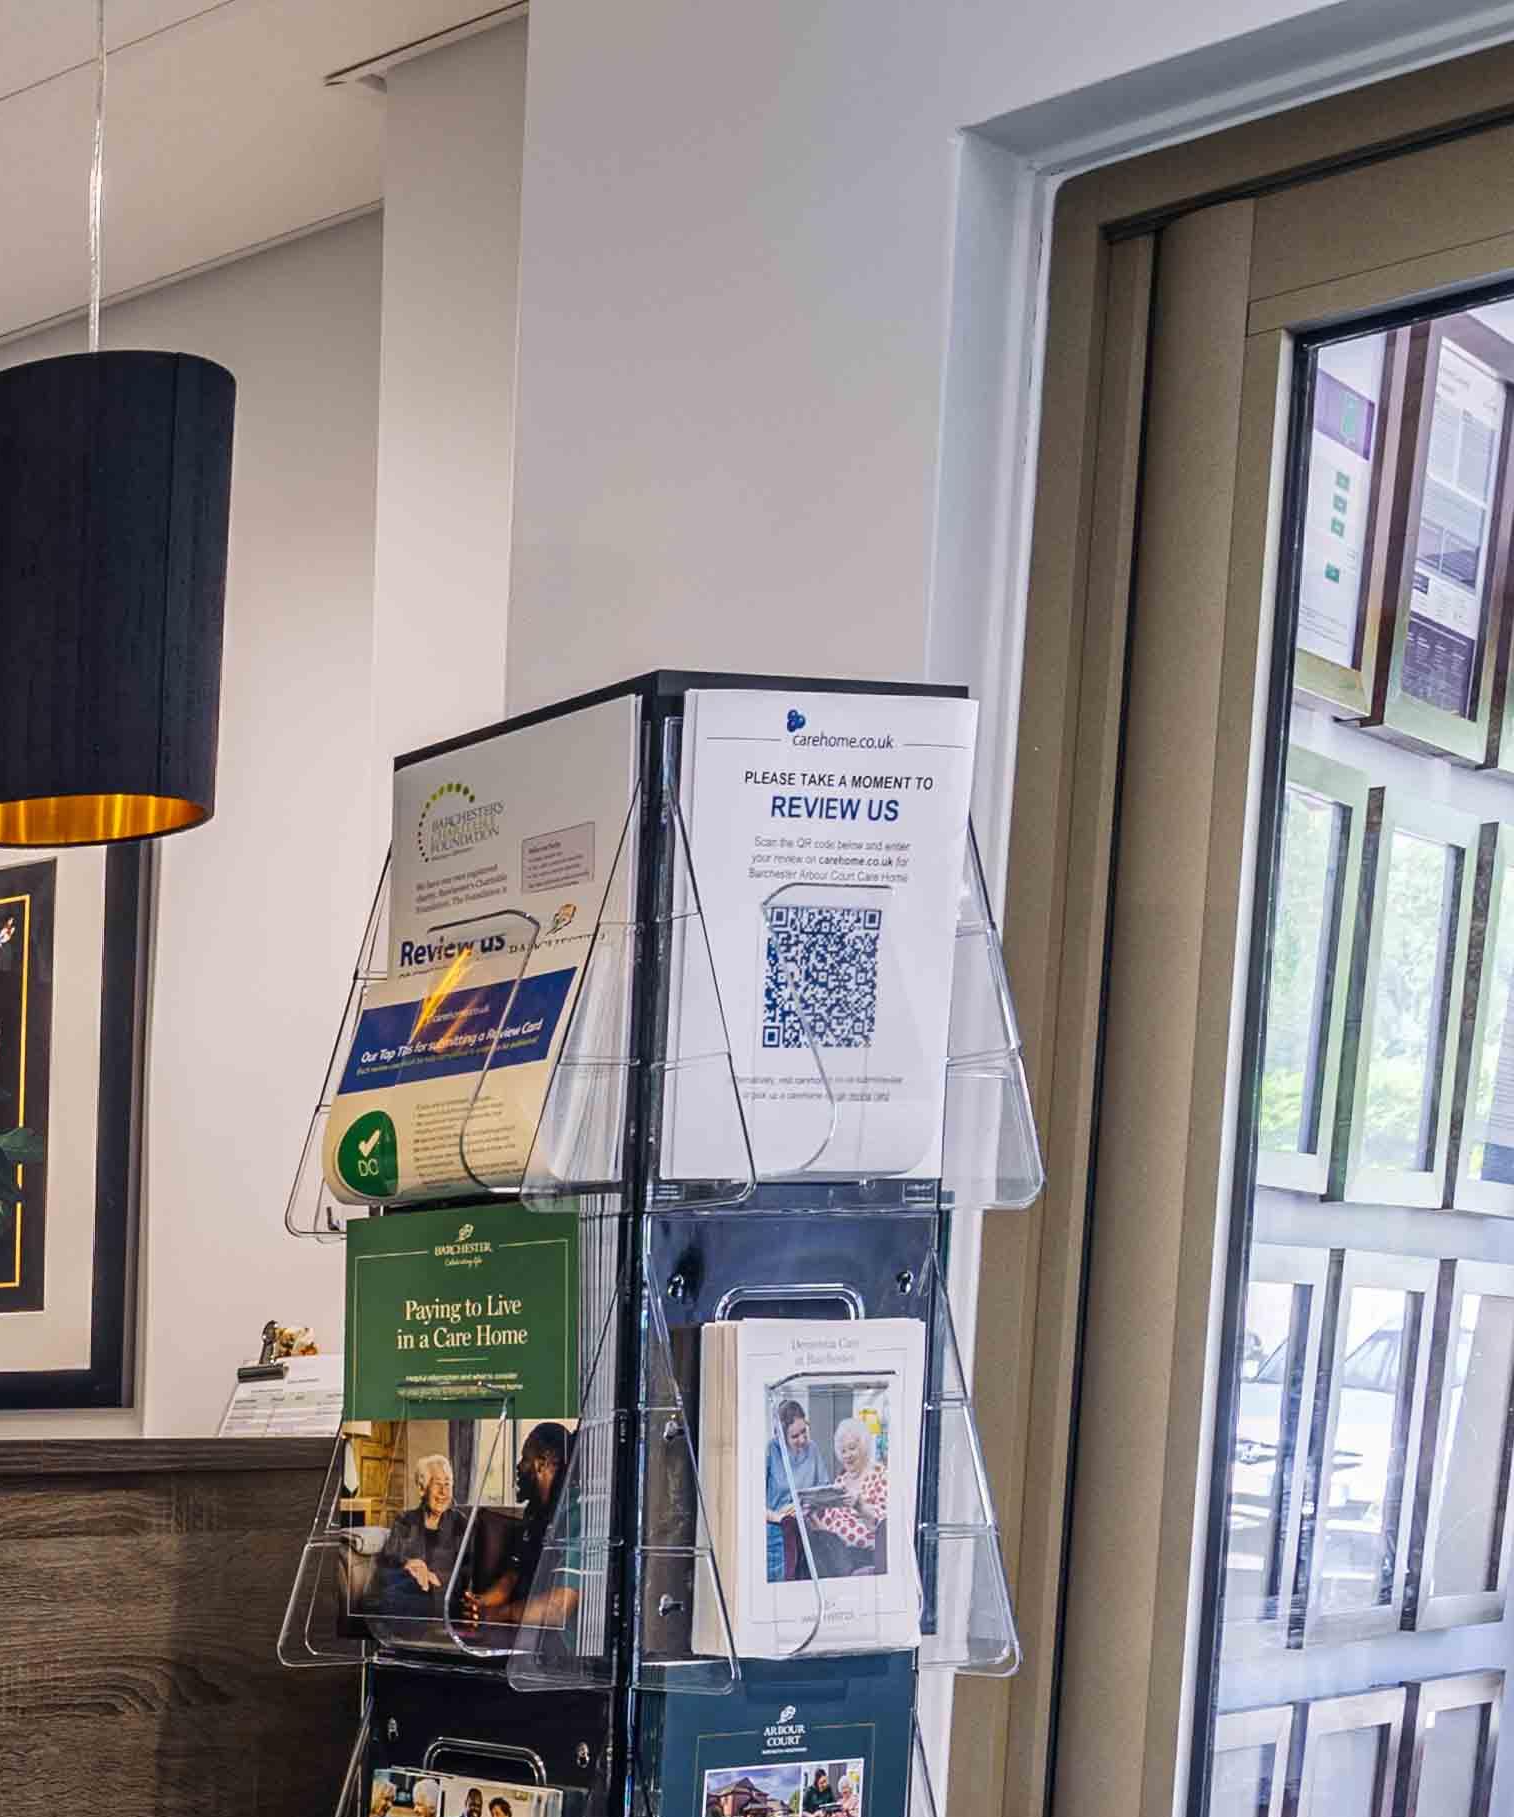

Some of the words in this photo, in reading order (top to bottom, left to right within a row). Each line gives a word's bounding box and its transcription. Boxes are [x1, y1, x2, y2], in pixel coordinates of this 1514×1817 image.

[792, 731, 894, 750] carehome.co.uk
[745, 771, 796, 786] PLEASE
[801, 773, 835, 787] TAKE
[838, 775, 847, 788] A
[851, 775, 911, 790] MOMENT
[915, 776, 933, 791] TO
[771, 796, 860, 820] REVIEW
[867, 799, 900, 822] US
[754, 836, 777, 848] Scan
[796, 837, 812, 849] QR
[814, 839, 835, 849] code
[818, 856, 893, 866] carehome.co.uk
[400, 936, 475, 967] Review
[480, 934, 506, 953] us
[361, 1052, 377, 1063] Our
[380, 1048, 395, 1062] Top
[414, 1041, 428, 1053] for
[522, 1018, 544, 1033] Card
[357, 1158, 379, 1177] DO
[434, 1241, 493, 1256] BARCHESTER
[405, 1297, 462, 1325] Paying
[465, 1298, 482, 1317] to
[487, 1293, 522, 1316] Live
[397, 1328, 415, 1349] in
[419, 1335, 429, 1348] a
[433, 1327, 471, 1348] Care
[476, 1324, 528, 1346] Home
[763, 1725, 806, 1736] ARBOUR
[767, 1735, 801, 1747] COURT
